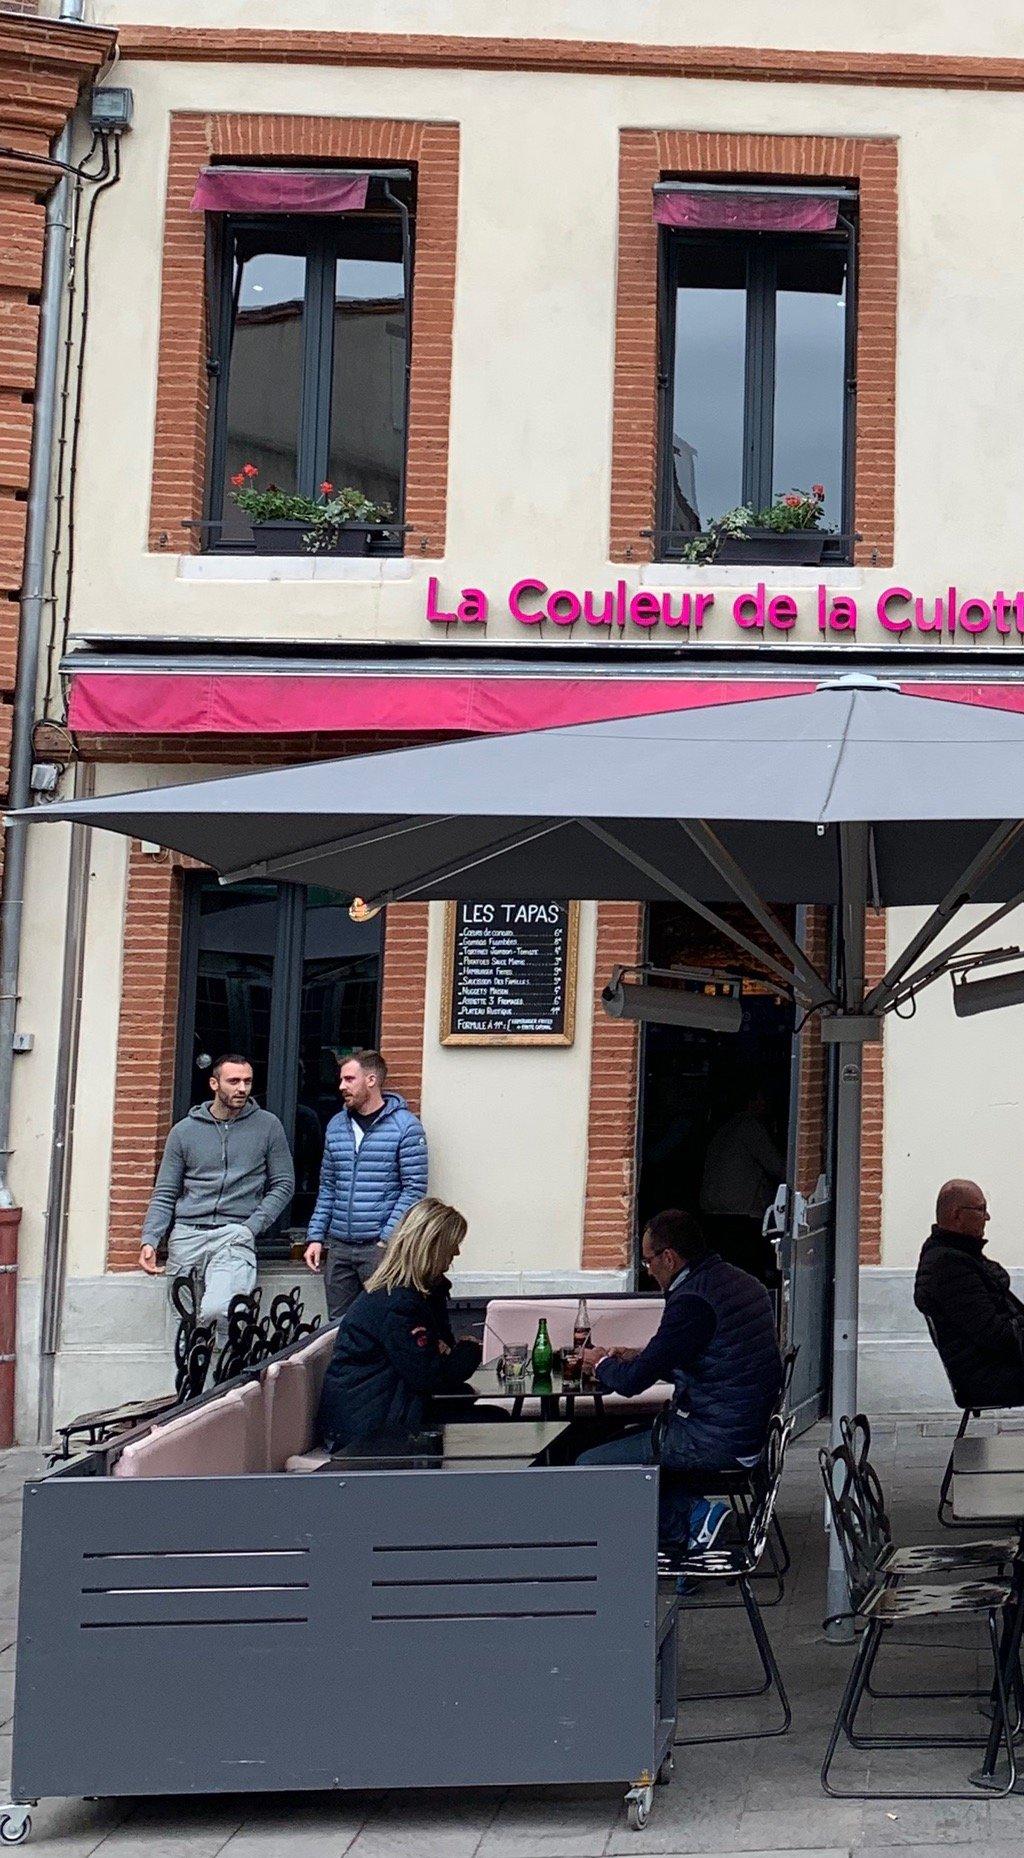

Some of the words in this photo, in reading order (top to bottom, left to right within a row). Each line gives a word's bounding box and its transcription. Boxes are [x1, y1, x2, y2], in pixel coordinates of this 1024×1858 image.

[426, 576, 488, 623] La
[508, 578, 715, 628] Couleur
[732, 582, 797, 630] de
[817, 583, 857, 631] la
[463, 904, 495, 923] LES
[500, 904, 560, 923] TAPAS
[488, 996, 495, 1006] 3
